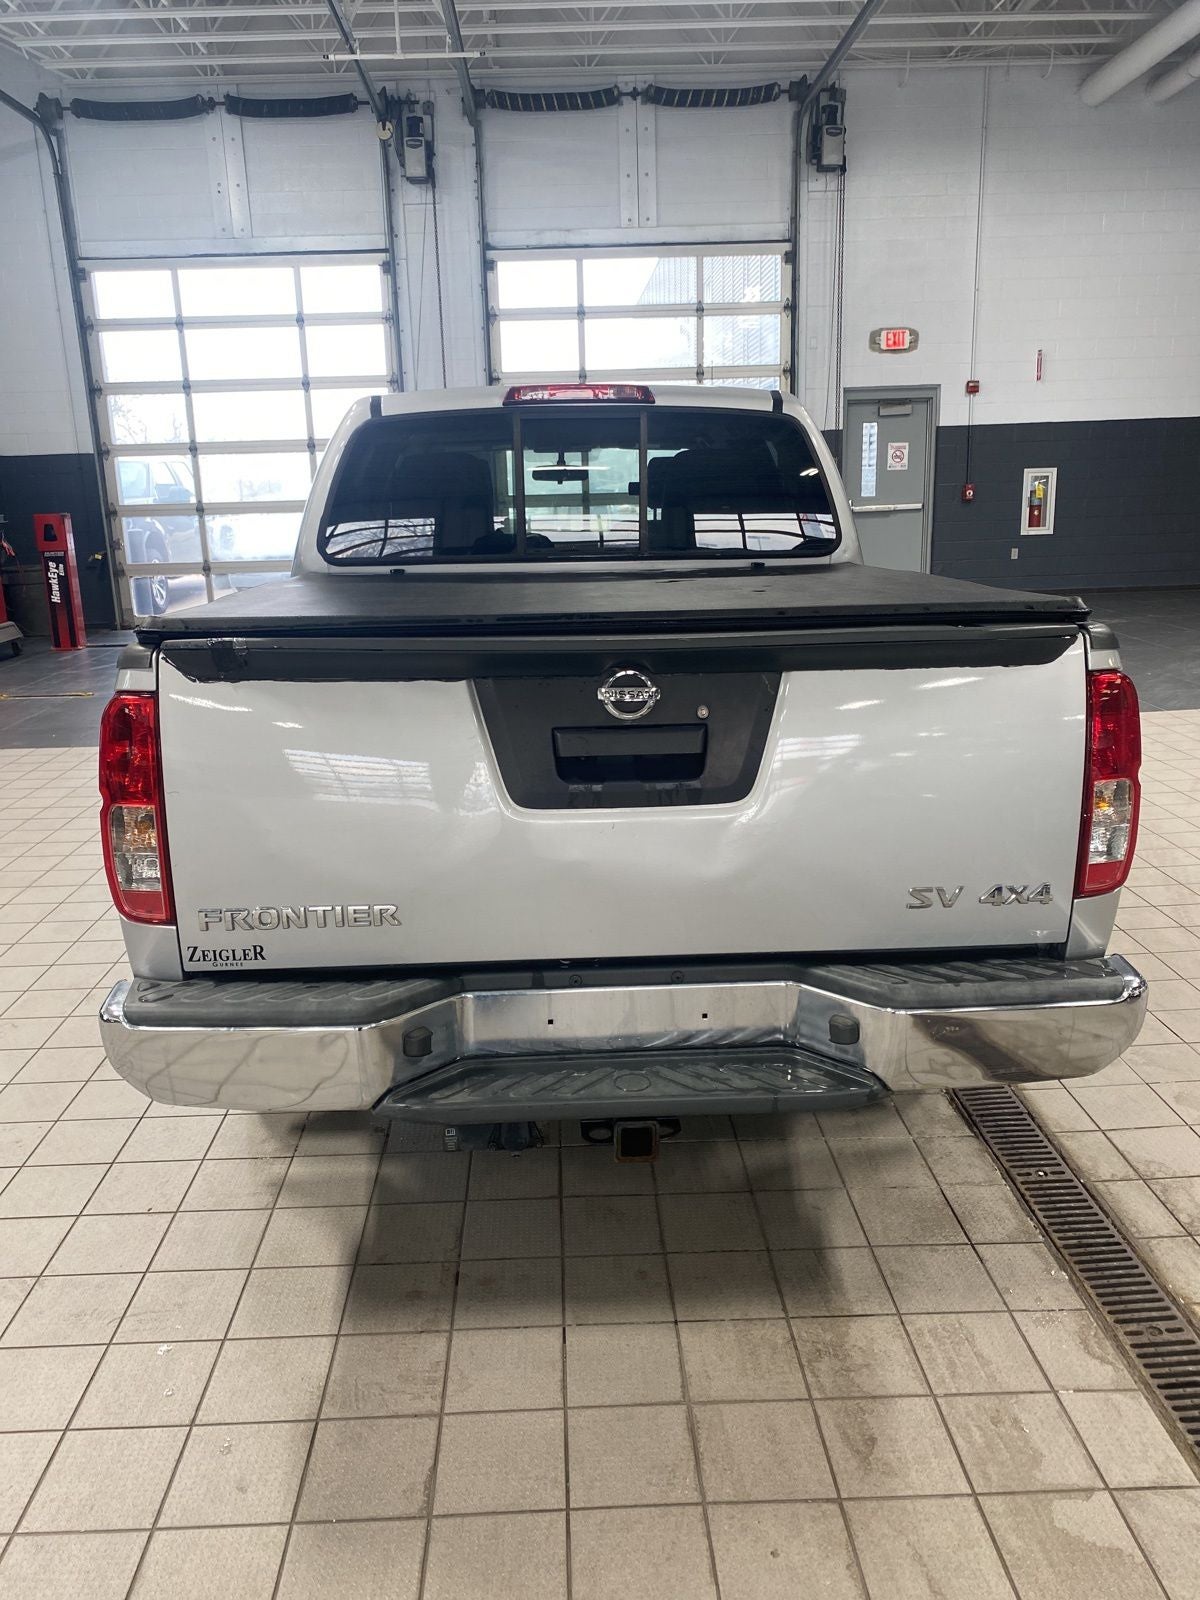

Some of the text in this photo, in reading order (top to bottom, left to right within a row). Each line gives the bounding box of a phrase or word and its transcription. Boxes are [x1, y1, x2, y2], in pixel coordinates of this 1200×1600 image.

[885, 330, 906, 348] EXIT
[48, 561, 61, 603] HawkEye
[604, 689, 657, 699] NISSAN
[906, 885, 965, 909] SV
[198, 904, 402, 931] FRONTIER
[187, 944, 267, 963] ZEIGLER
